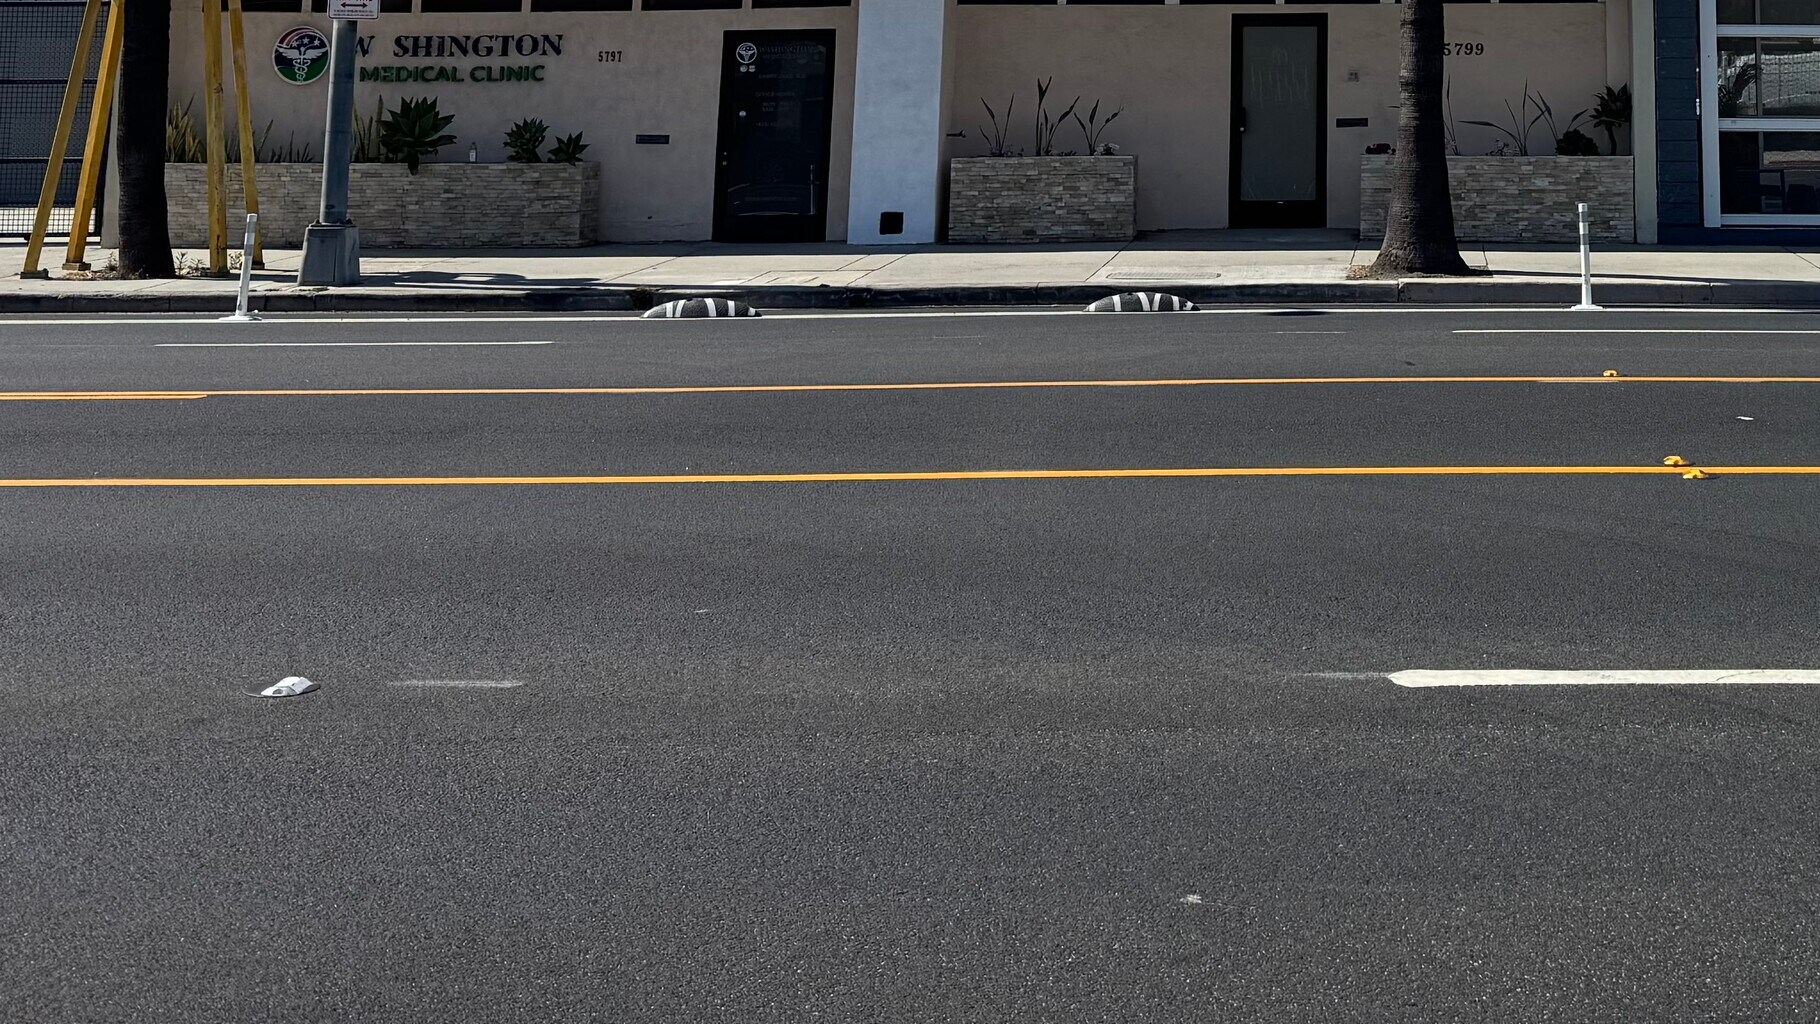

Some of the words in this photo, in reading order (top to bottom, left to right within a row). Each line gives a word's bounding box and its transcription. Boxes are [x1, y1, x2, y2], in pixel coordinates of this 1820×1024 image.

[1443, 42, 1484, 56] 5799
[598, 51, 622, 62] 5797
[359, 65, 465, 83] MEDICAL
[469, 64, 546, 83] CLINIC
